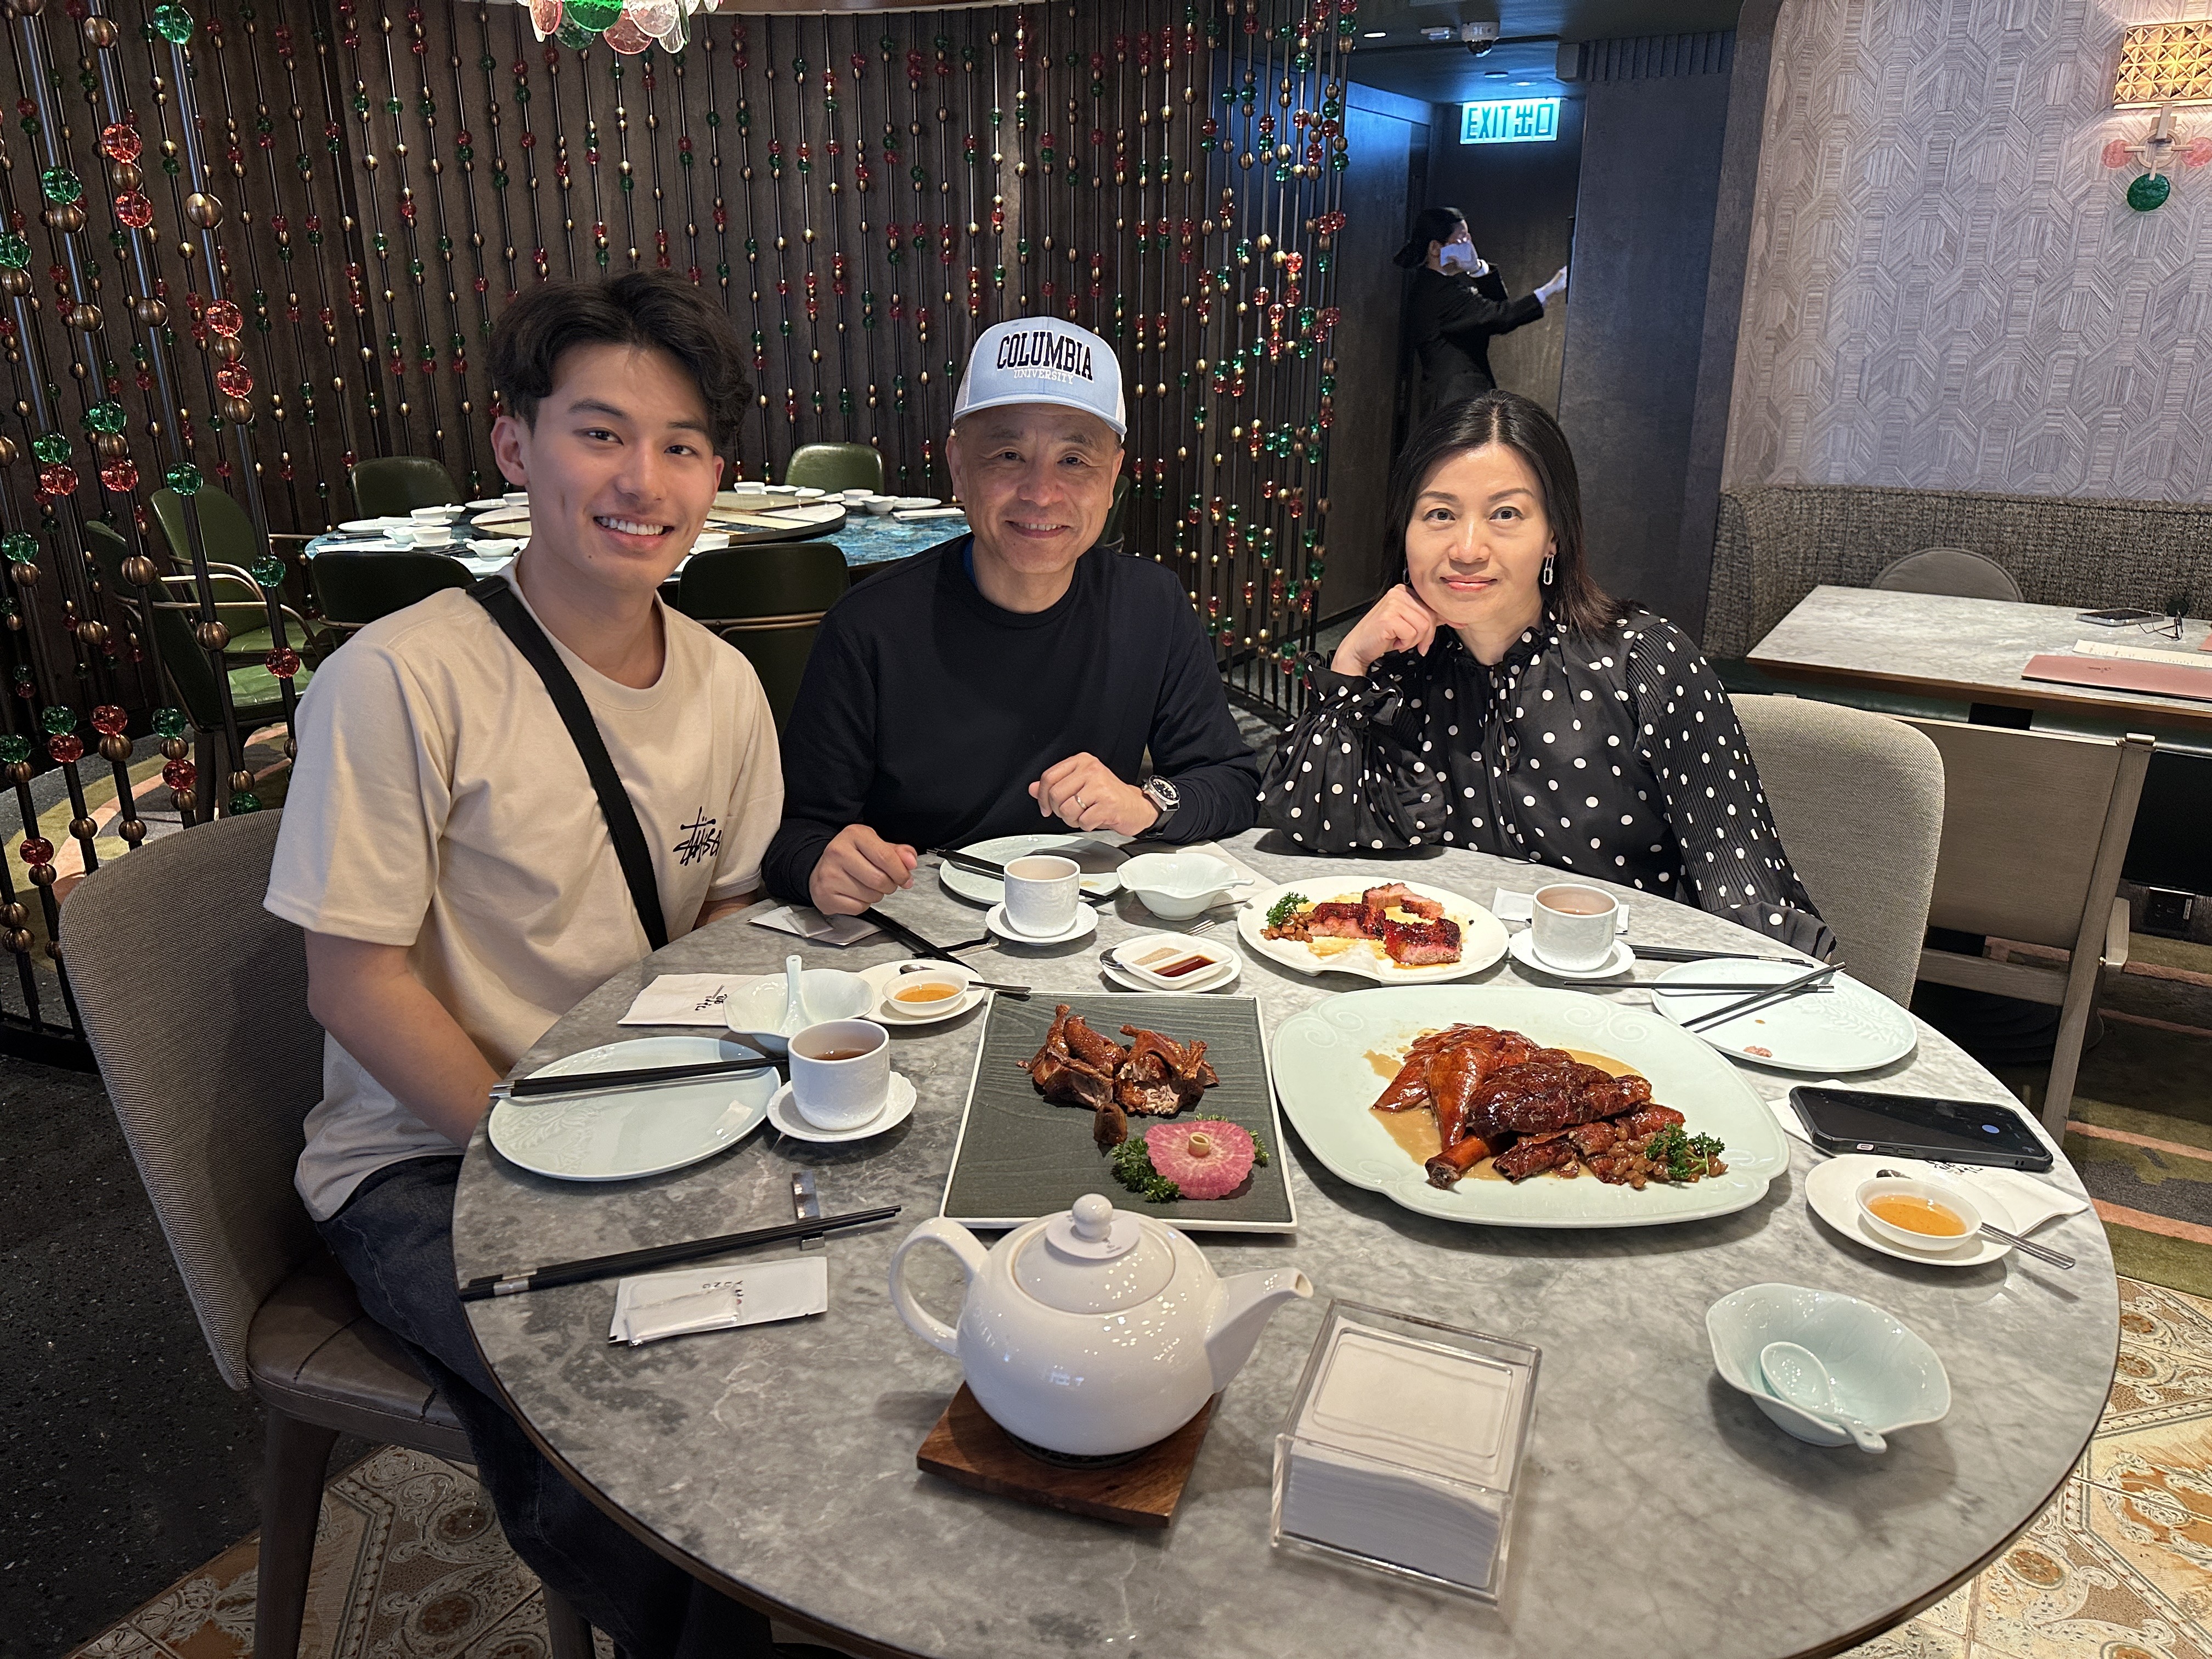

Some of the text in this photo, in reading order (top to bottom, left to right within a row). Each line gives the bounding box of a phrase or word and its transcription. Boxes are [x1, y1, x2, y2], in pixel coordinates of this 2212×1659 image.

[1466, 104, 1554, 139] EXIT 出口
[997, 330, 1094, 382] COLUMBIA
[1013, 369, 1075, 384] UNIVERSITY
